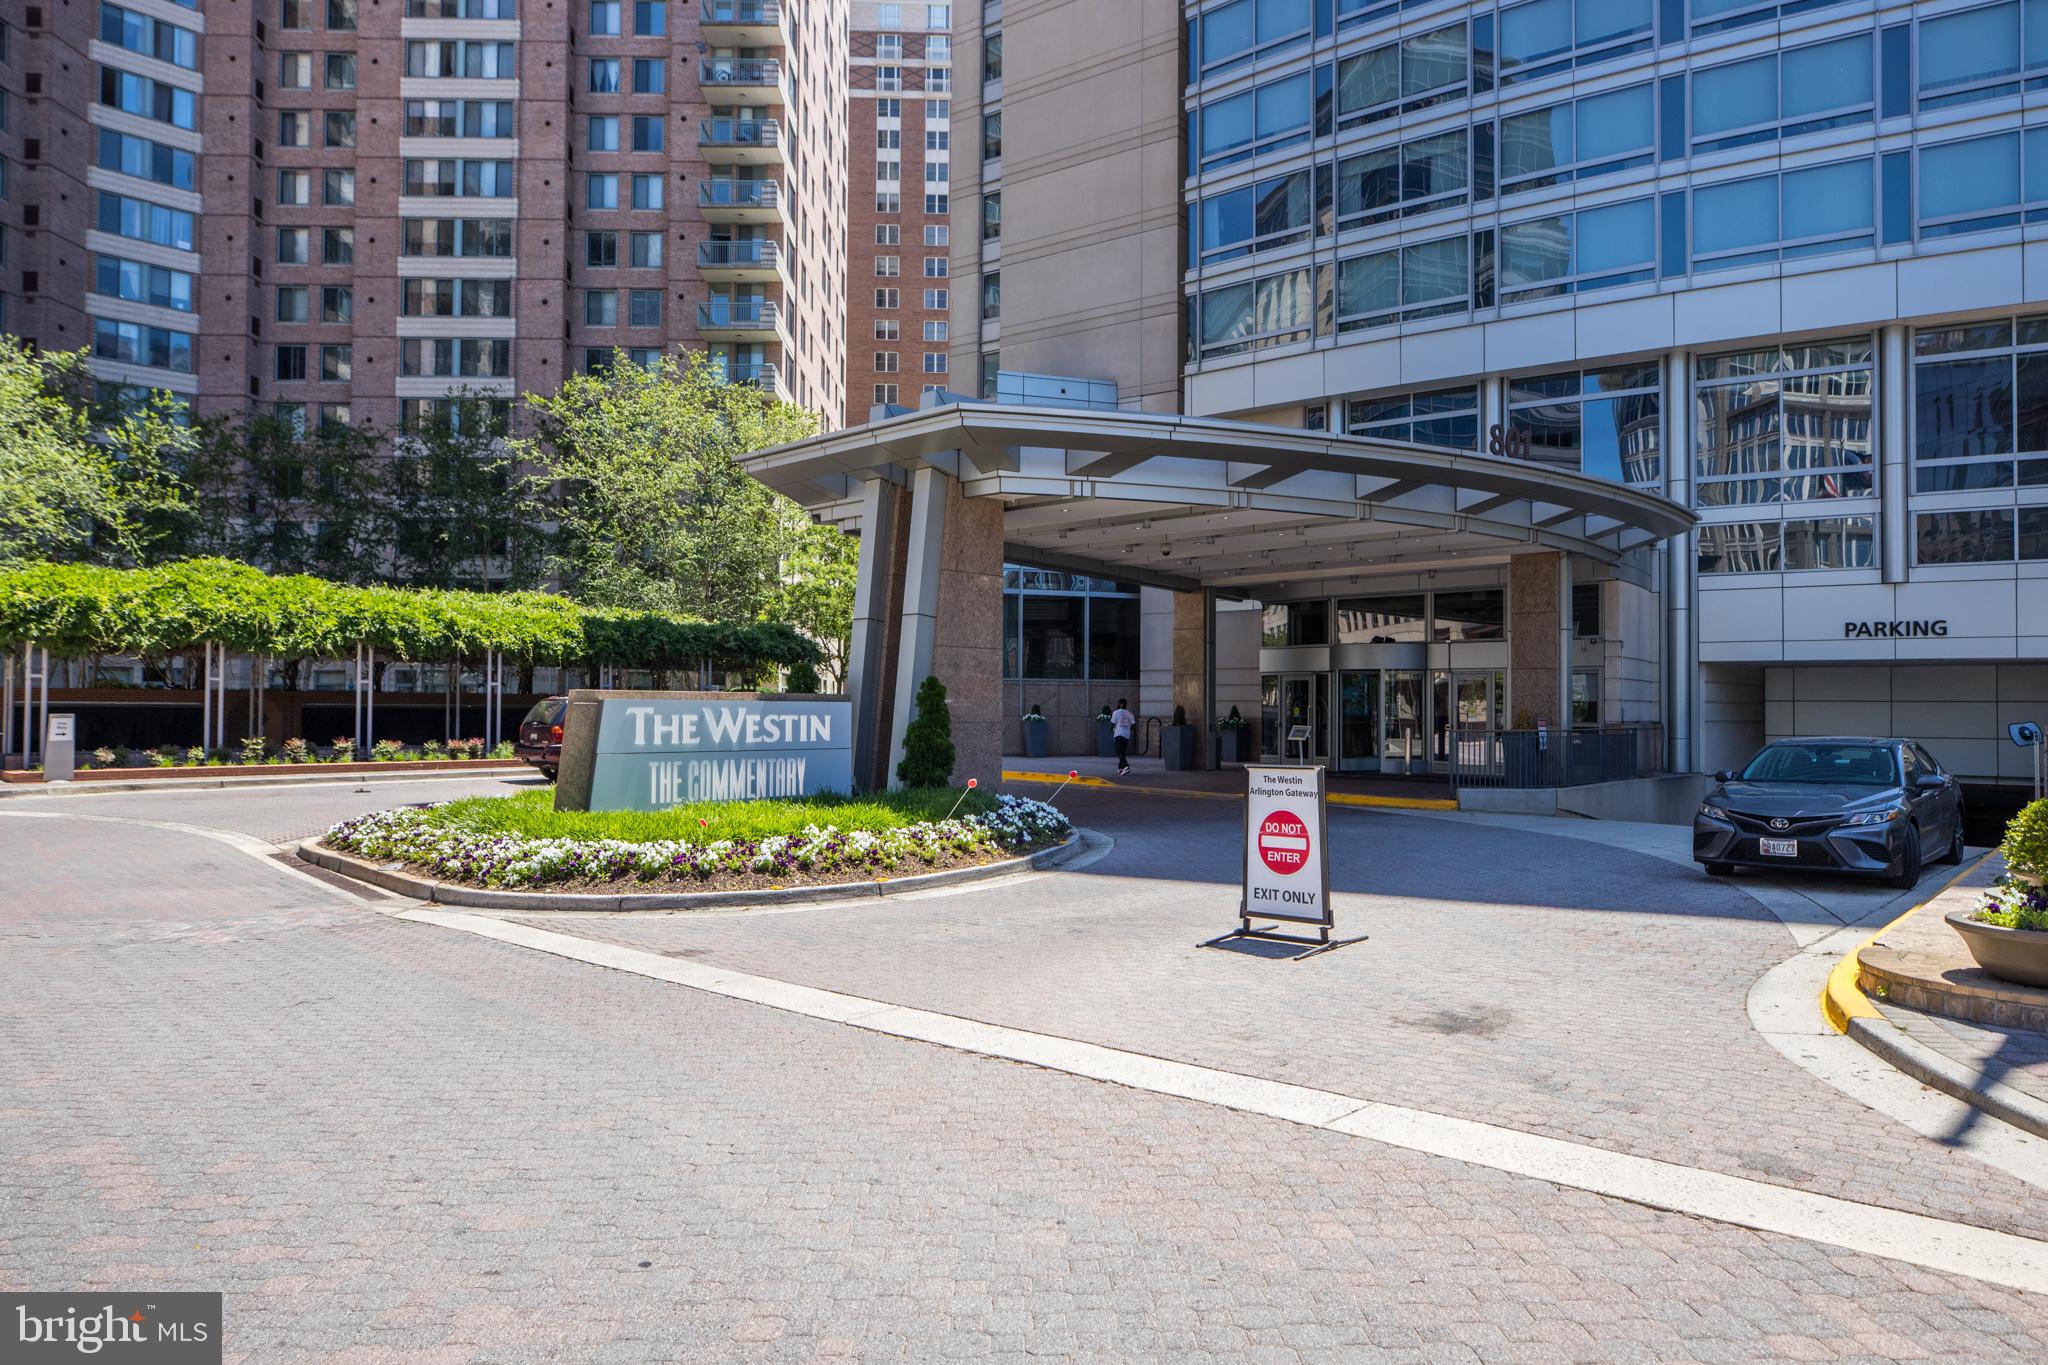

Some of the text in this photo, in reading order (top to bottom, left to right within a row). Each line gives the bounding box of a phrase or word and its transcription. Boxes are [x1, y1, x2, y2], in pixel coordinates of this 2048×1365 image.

[1490, 423, 1533, 460] 801
[1844, 620, 1948, 638] PARKING
[626, 706, 832, 745] THE WESTIN
[649, 757, 806, 804] THE COMMENTARY
[1263, 775, 1303, 785] The Westin
[1250, 787, 1318, 800] Arlington Gateway
[1265, 822, 1302, 834] DO NOT
[1267, 852, 1301, 864] ENTER
[1254, 887, 1316, 905] EXIT ONLY
